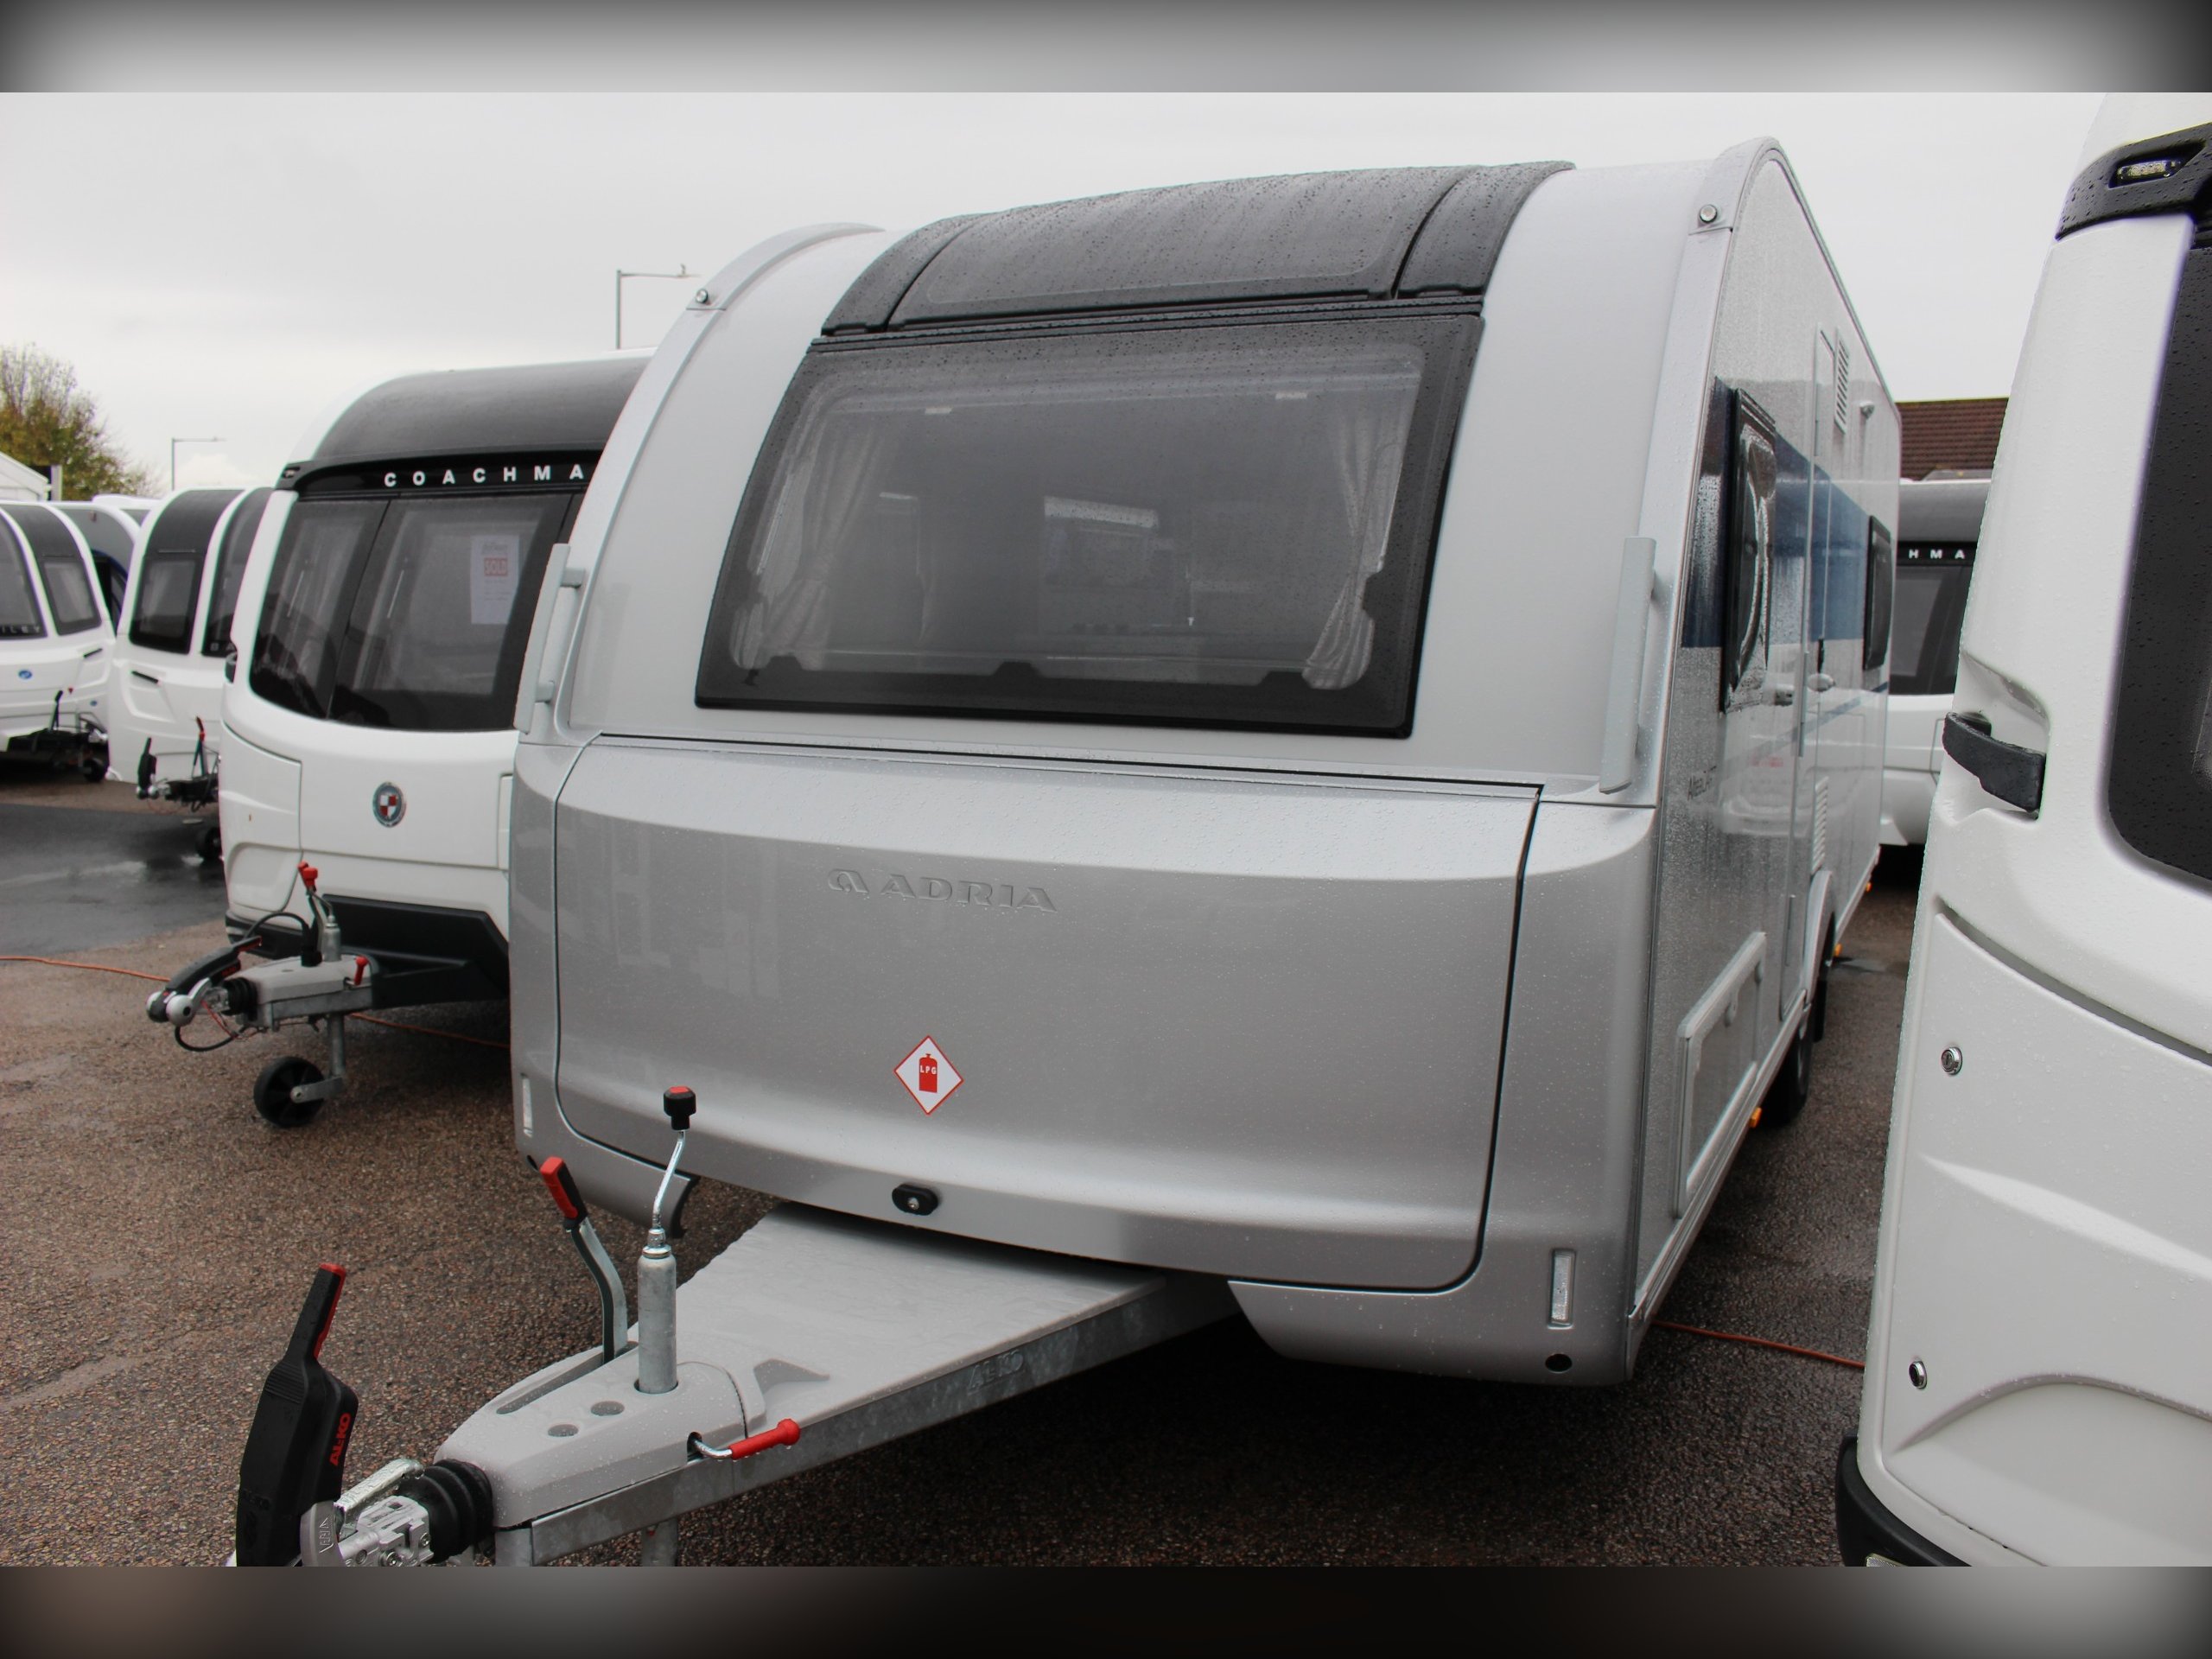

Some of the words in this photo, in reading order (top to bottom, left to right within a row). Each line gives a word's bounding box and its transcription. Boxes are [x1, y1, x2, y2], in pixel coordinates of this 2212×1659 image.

[384, 464, 585, 487] COACHMA
[1908, 548, 1966, 560] HMA
[485, 560, 506, 575] SOLD
[880, 874, 1058, 912] ADRIA
[919, 1065, 937, 1075] LPG
